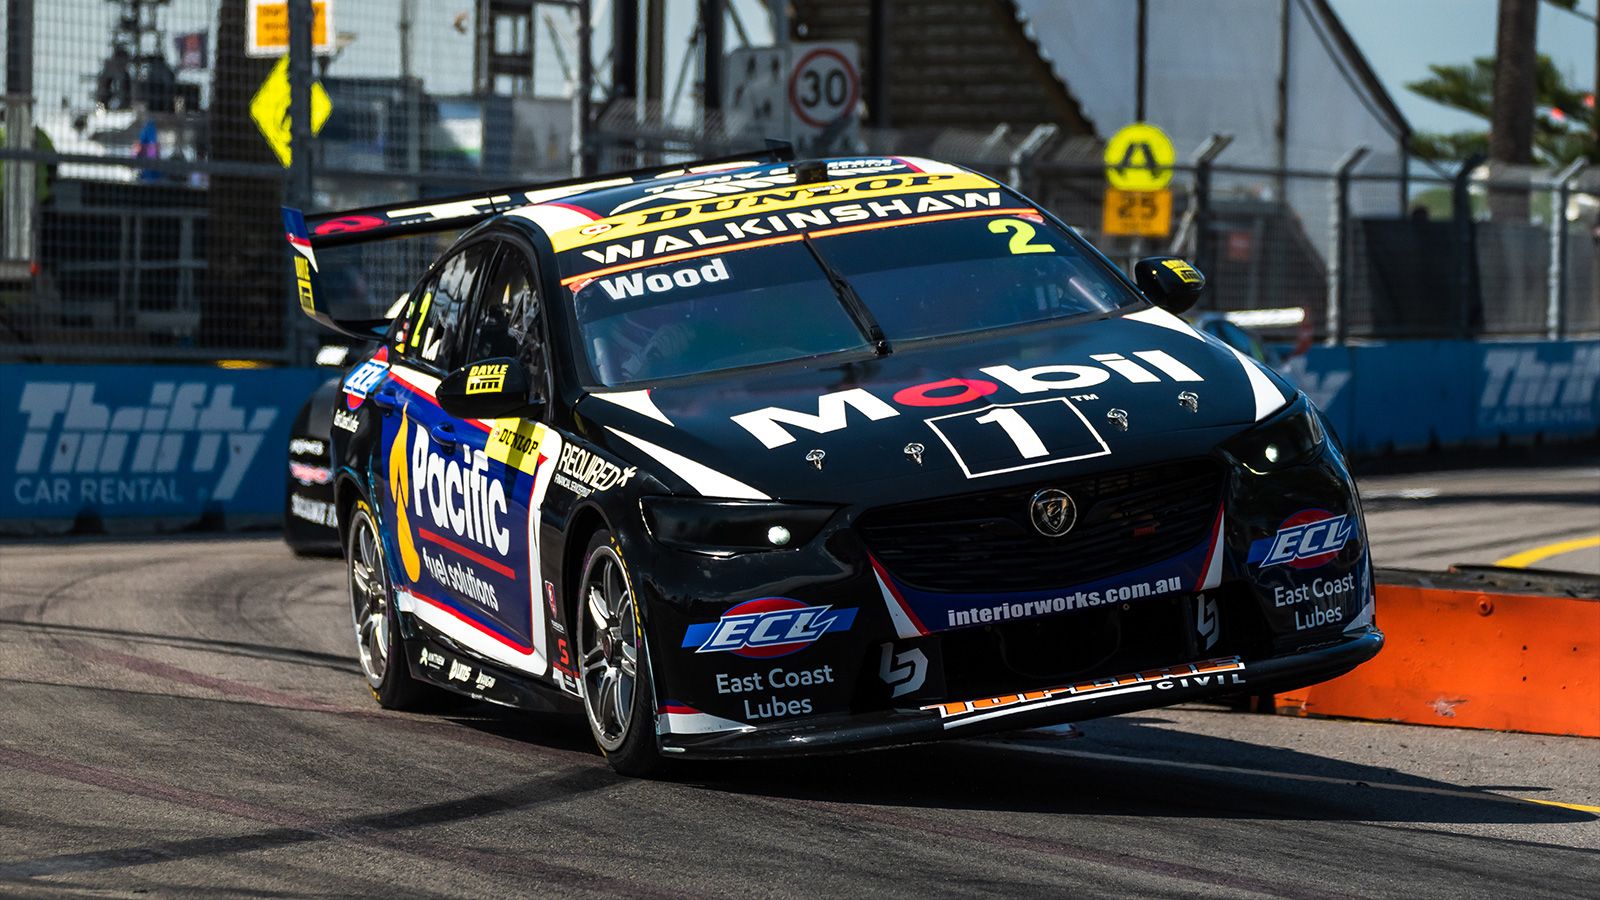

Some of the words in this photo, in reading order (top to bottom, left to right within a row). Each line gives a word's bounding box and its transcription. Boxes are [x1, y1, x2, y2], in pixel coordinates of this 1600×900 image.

[802, 69, 848, 109] 30
[637, 174, 955, 227] DUNLOP
[644, 171, 762, 194] TONY
[582, 192, 1000, 264] WALKINSHAW
[987, 219, 1056, 254] 2
[598, 257, 730, 300] Wood
[468, 364, 509, 377] DAYLE
[730, 350, 1205, 450] Mobil
[15, 381, 280, 501] Thrifty
[498, 428, 540, 455] DUNLOP
[975, 407, 1051, 460] 1
[557, 441, 622, 492] REQUIRED
[14, 478, 71, 505] CAR
[80, 478, 182, 505] RENTAL
[412, 424, 510, 557] Pacific
[1264, 517, 1347, 565] ECL
[422, 546, 452, 588] fuel
[448, 562, 499, 612] solutions
[1274, 583, 1310, 608] East
[1312, 572, 1355, 598] Coast
[947, 576, 1182, 627] interiorworks.com.au
[1295, 605, 1343, 631] Lubes
[703, 606, 832, 651] ECL
[716, 672, 764, 694] East
[768, 664, 835, 689] Coast
[1156, 673, 1247, 691] CIVIL
[743, 696, 813, 720] Lubes
